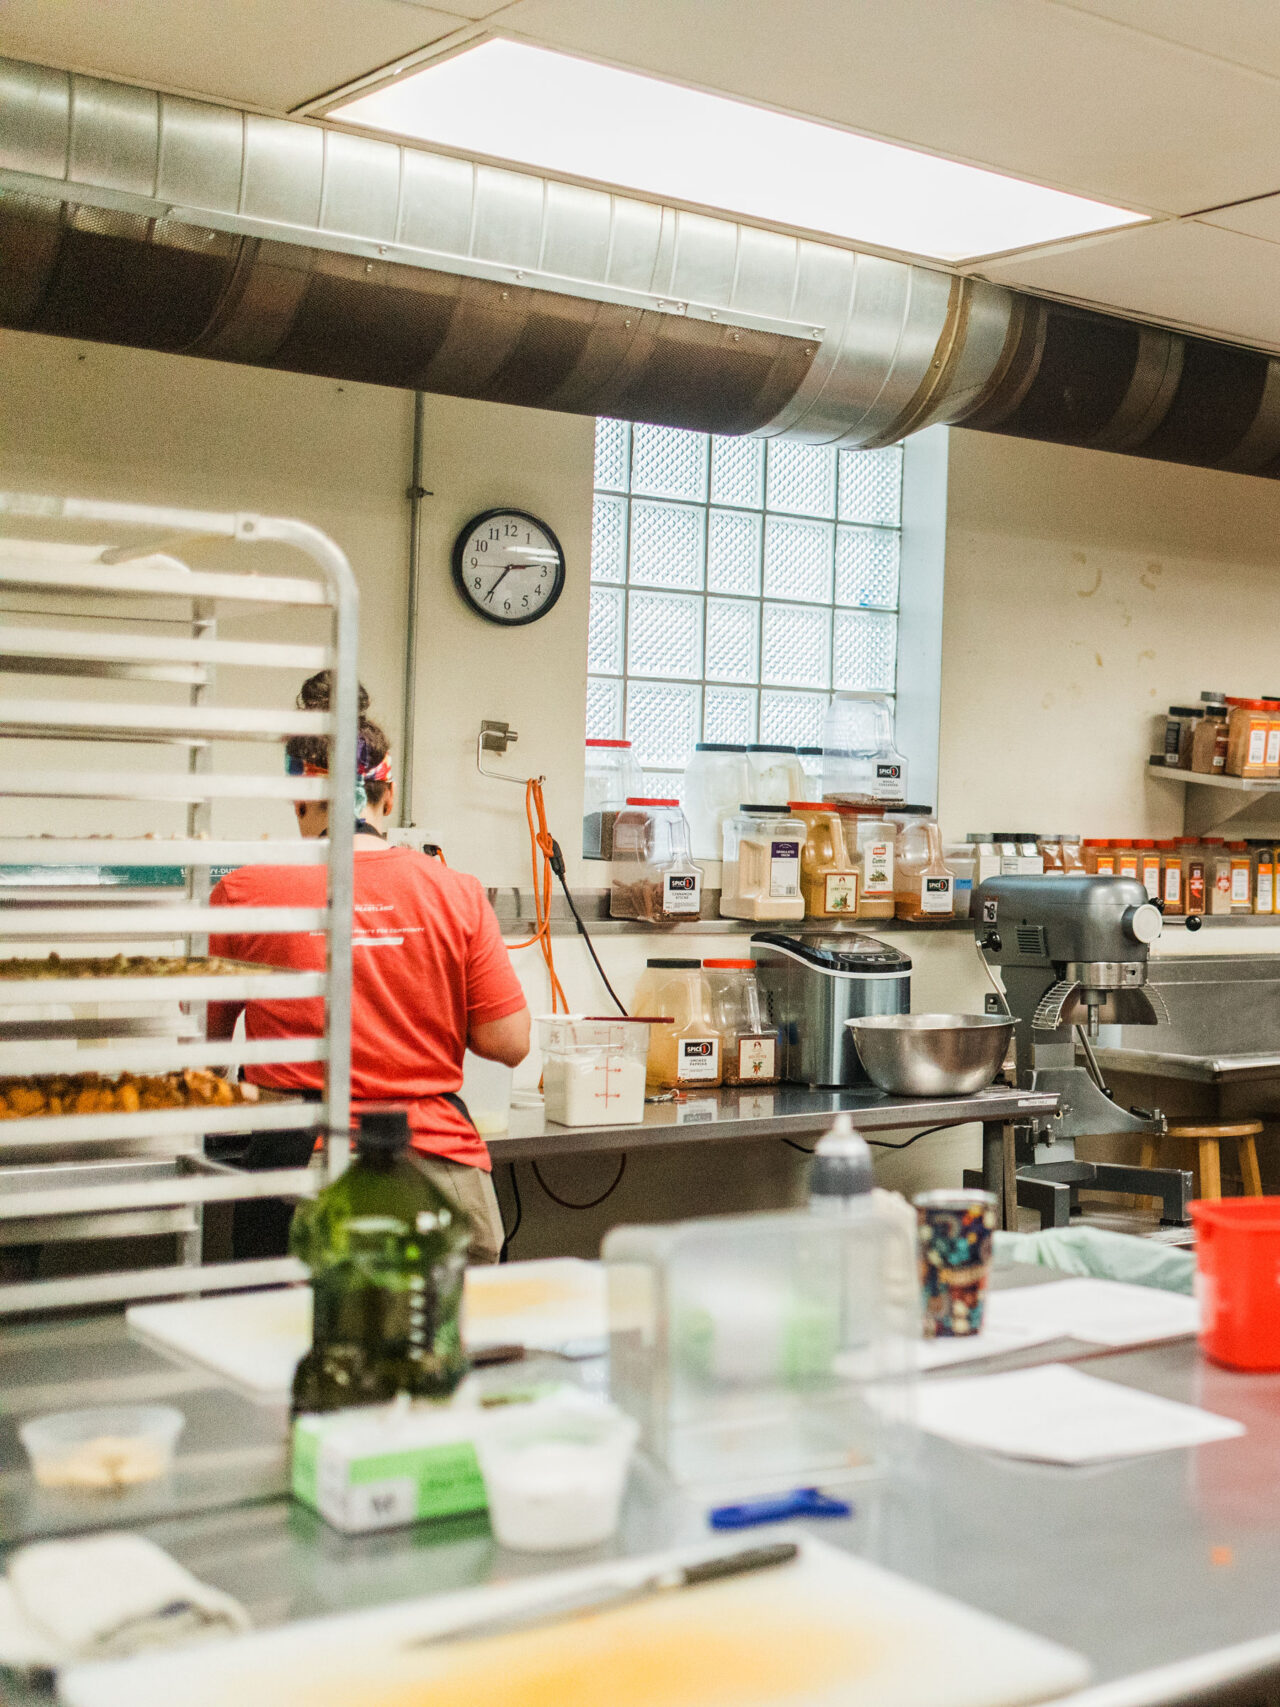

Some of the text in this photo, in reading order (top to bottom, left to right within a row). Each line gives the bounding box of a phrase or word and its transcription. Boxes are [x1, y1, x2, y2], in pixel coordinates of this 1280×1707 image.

[488, 528, 500, 541] 11
[504, 524, 518, 537] 12
[526, 533, 531, 544] 1
[474, 540, 488, 552] 10
[470, 558, 478, 569] 9
[540, 565, 548, 578] 3
[474, 577, 482, 589] 8
[534, 584, 541, 595] 4
[503, 599, 511, 610] 6
[521, 595, 529, 607] 5
